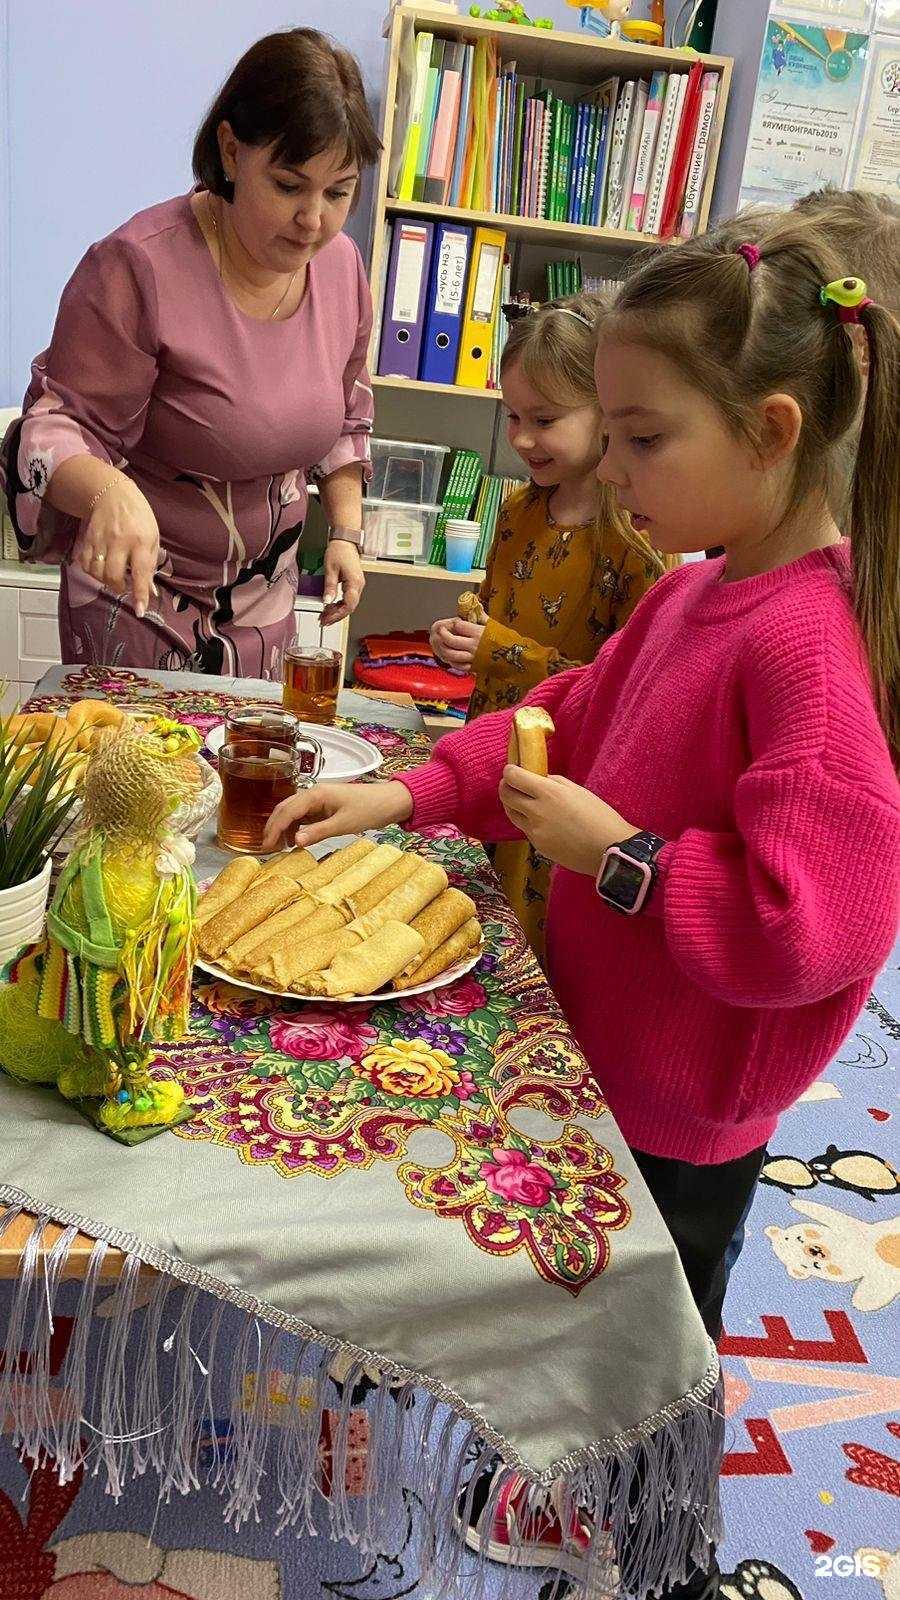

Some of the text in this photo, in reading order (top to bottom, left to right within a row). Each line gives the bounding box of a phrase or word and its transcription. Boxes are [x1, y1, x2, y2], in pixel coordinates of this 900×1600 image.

[685, 101, 713, 209] Обучение грамоте
[441, 253, 450, 267] на
[454, 256, 465, 279] лет)
